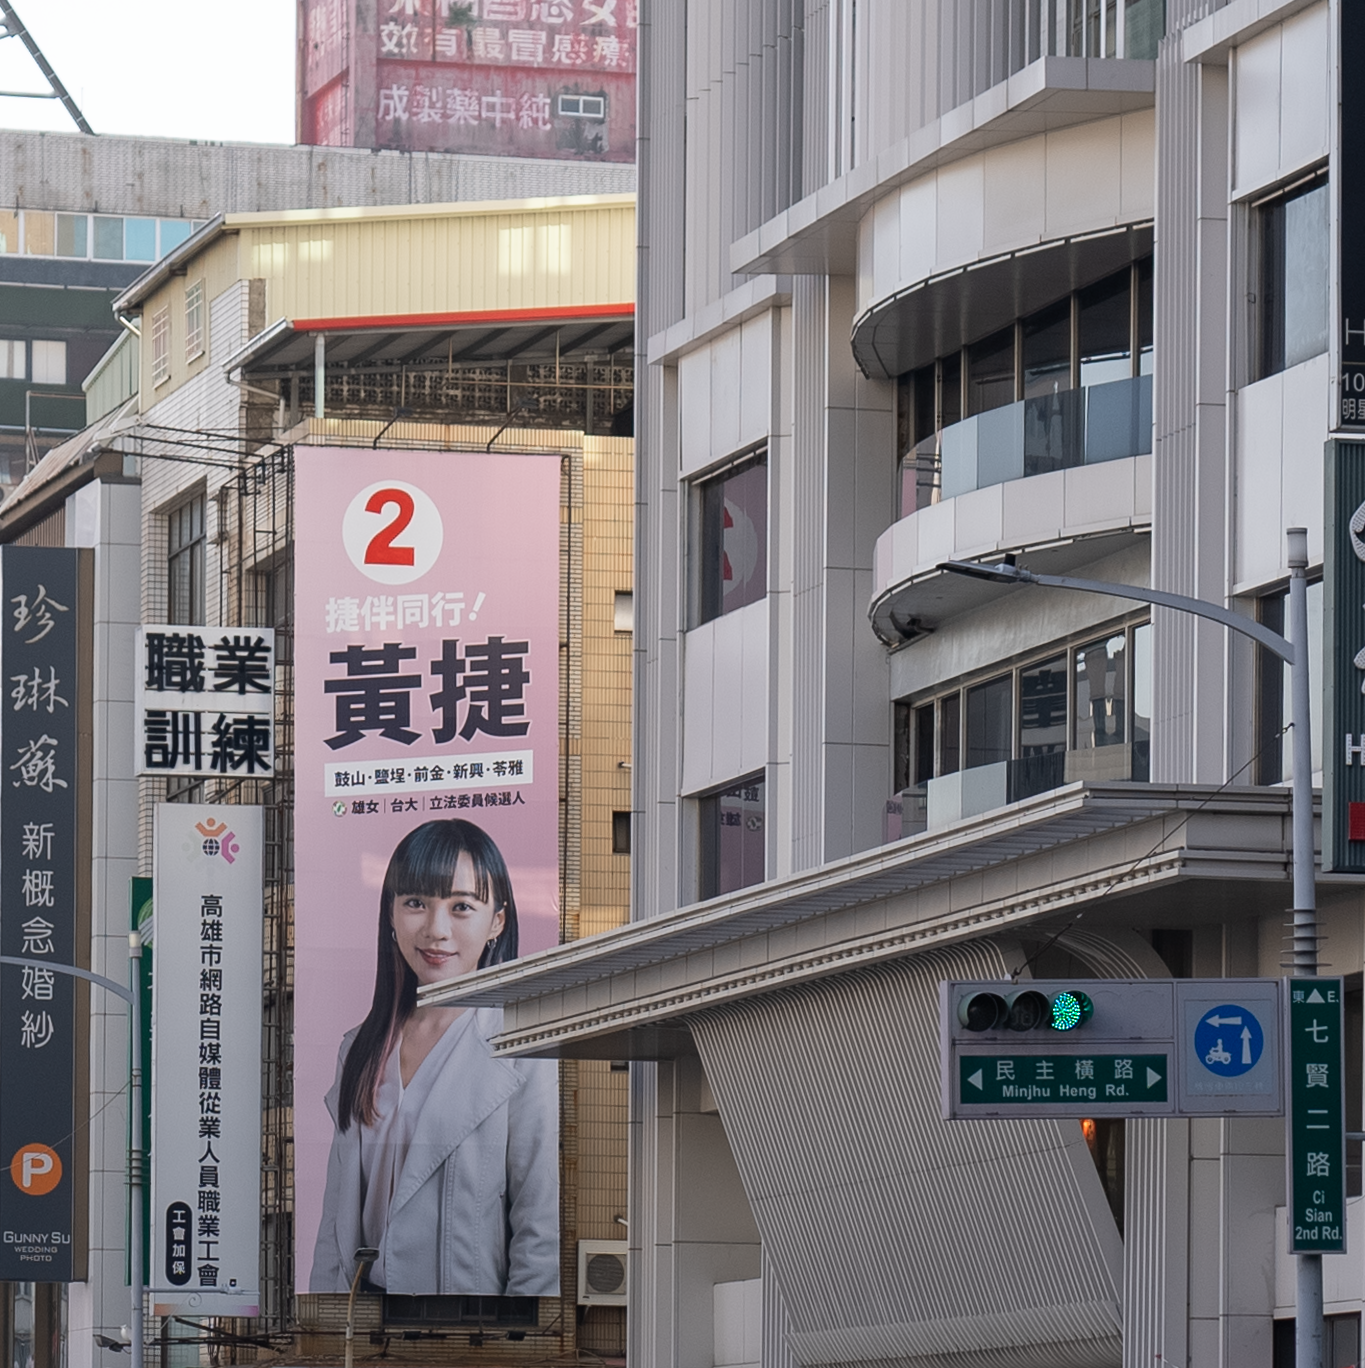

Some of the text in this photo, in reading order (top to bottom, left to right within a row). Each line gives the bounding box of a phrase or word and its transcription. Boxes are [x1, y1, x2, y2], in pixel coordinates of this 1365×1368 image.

[364, 488, 415, 566] 2
[145, 632, 270, 694] 職業
[323, 635, 531, 750] 黃捷
[144, 709, 271, 775] 訓練
[9, 584, 69, 1050] 珍琳蘇 新概念婚紗
[351, 791, 526, 815] 雄女 台大 立法委員候選人
[1293, 991, 1304, 1003] 東
[197, 895, 223, 1287] 高雄市網路自媒體從業人員職業工會
[996, 1059, 1134, 1081] 民主橫路
[1002, 1084, 1130, 1099] Minjhu Heng Rd.
[1305, 1019, 1331, 1178] 七賢二路
[21, 1152, 54, 1188] P
[1305, 1209, 1332, 1223] Sian
[1313, 1191, 1325, 1204] Ci
[172, 1209, 186, 1275] 工會加保
[1295, 1227, 1343, 1241] 2nd Rd.
